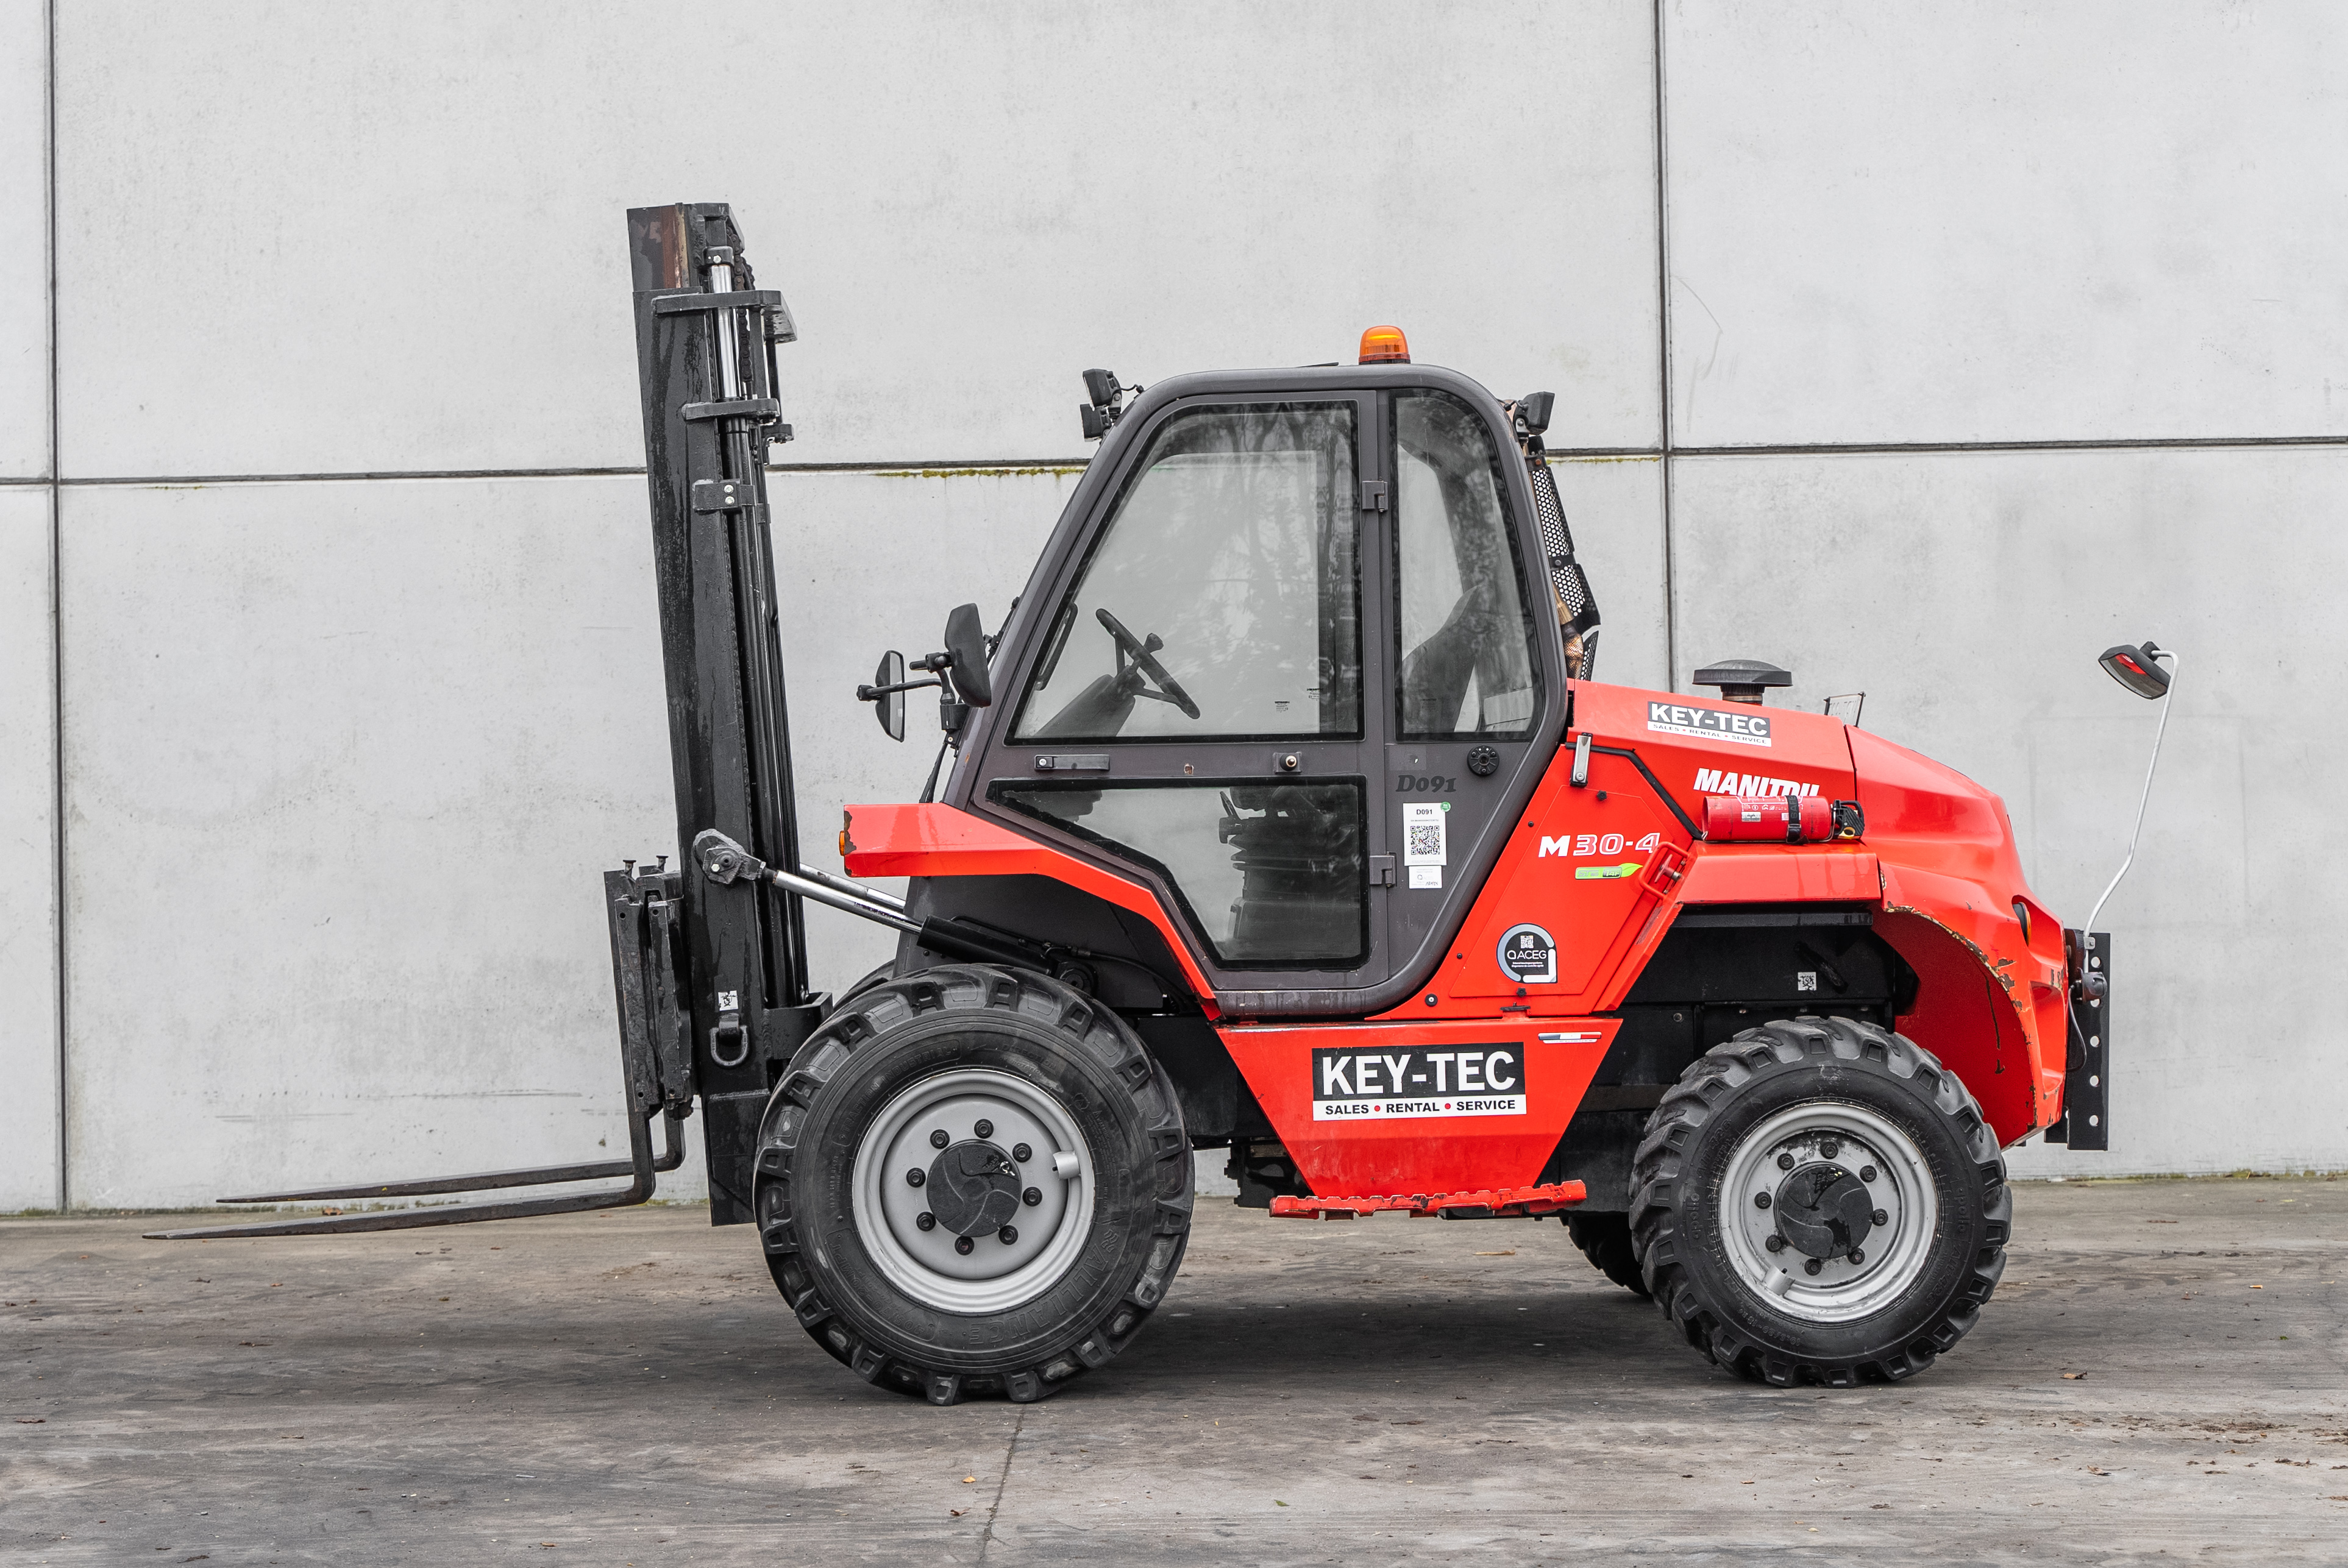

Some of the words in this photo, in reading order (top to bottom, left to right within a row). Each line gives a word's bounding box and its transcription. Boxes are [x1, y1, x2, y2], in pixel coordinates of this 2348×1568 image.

[1651, 703, 1767, 736] KEY-TEC
[1652, 723, 1680, 732] SALES
[1689, 728, 1722, 738] RENTAL
[1731, 734, 1767, 745] SERVICE
[1395, 775, 1457, 792] D091
[841, 1082, 880, 1132] TRACTION
[881, 1047, 952, 1084] INDUSTRIAL
[1322, 1051, 1516, 1096] KEY-TEC
[1325, 1104, 1370, 1115] SALES
[1386, 1102, 1440, 1113] RENTAL
[1456, 1099, 1516, 1111] SERVICE
[1953, 1188, 1970, 1233] apollo
[969, 1243, 1109, 1345] ALLIANCE
